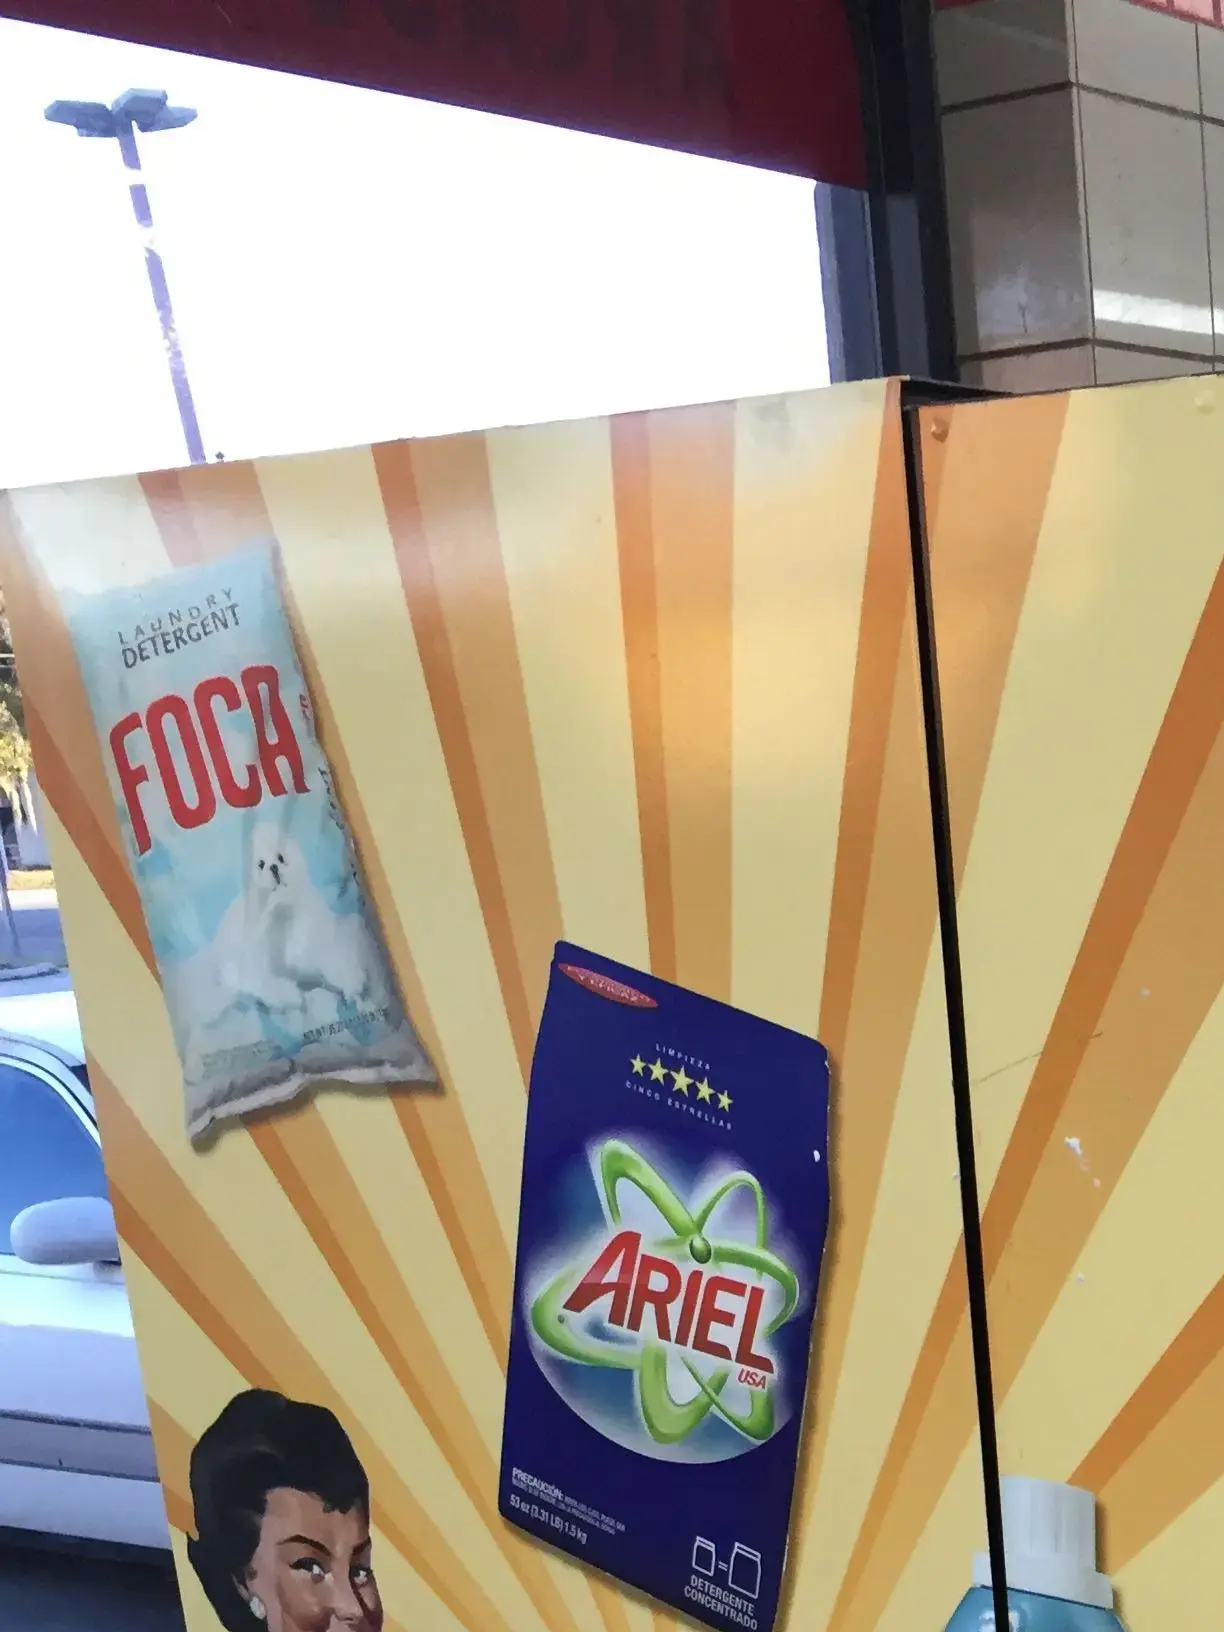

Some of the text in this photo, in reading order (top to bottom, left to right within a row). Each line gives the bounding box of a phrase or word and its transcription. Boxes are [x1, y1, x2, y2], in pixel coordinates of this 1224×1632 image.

[118, 587, 234, 646] LAUNDRY
[121, 603, 241, 670] DETERGENT
[109, 664, 312, 857] FOCA
[655, 1043, 711, 1071] LIMPIEZA
[625, 1080, 733, 1131] CINCO ESTRELLAS
[562, 1231, 774, 1374] ARIEL
[738, 1367, 766, 1389] USA
[510, 1494, 521, 1509] 53
[684, 1586, 758, 1632] CONCENTRADO
[690, 1574, 755, 1616] DETERGENTE
